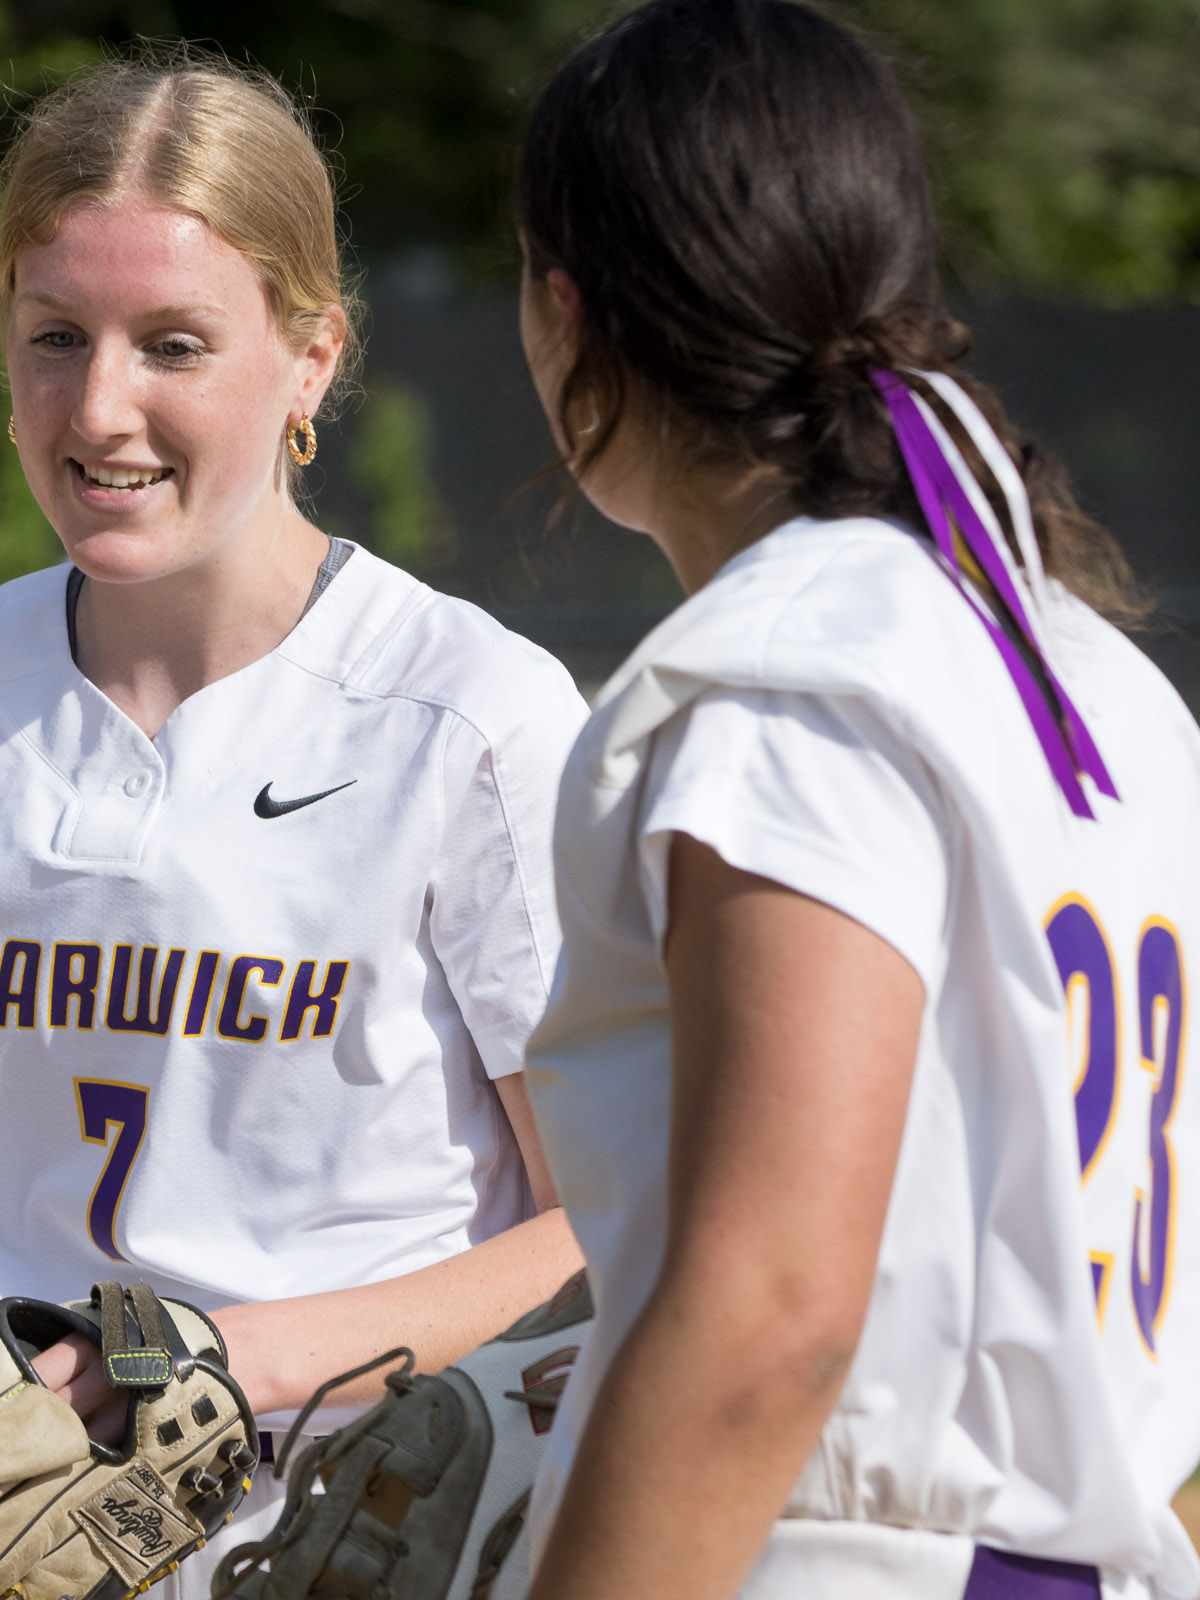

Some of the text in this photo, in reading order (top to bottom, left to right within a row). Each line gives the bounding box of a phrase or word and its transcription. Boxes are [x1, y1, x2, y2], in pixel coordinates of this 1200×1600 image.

[72, 1076, 150, 1263] 7
[1041, 890, 1188, 1364] 23
[101, 1498, 172, 1557] Rawlings
